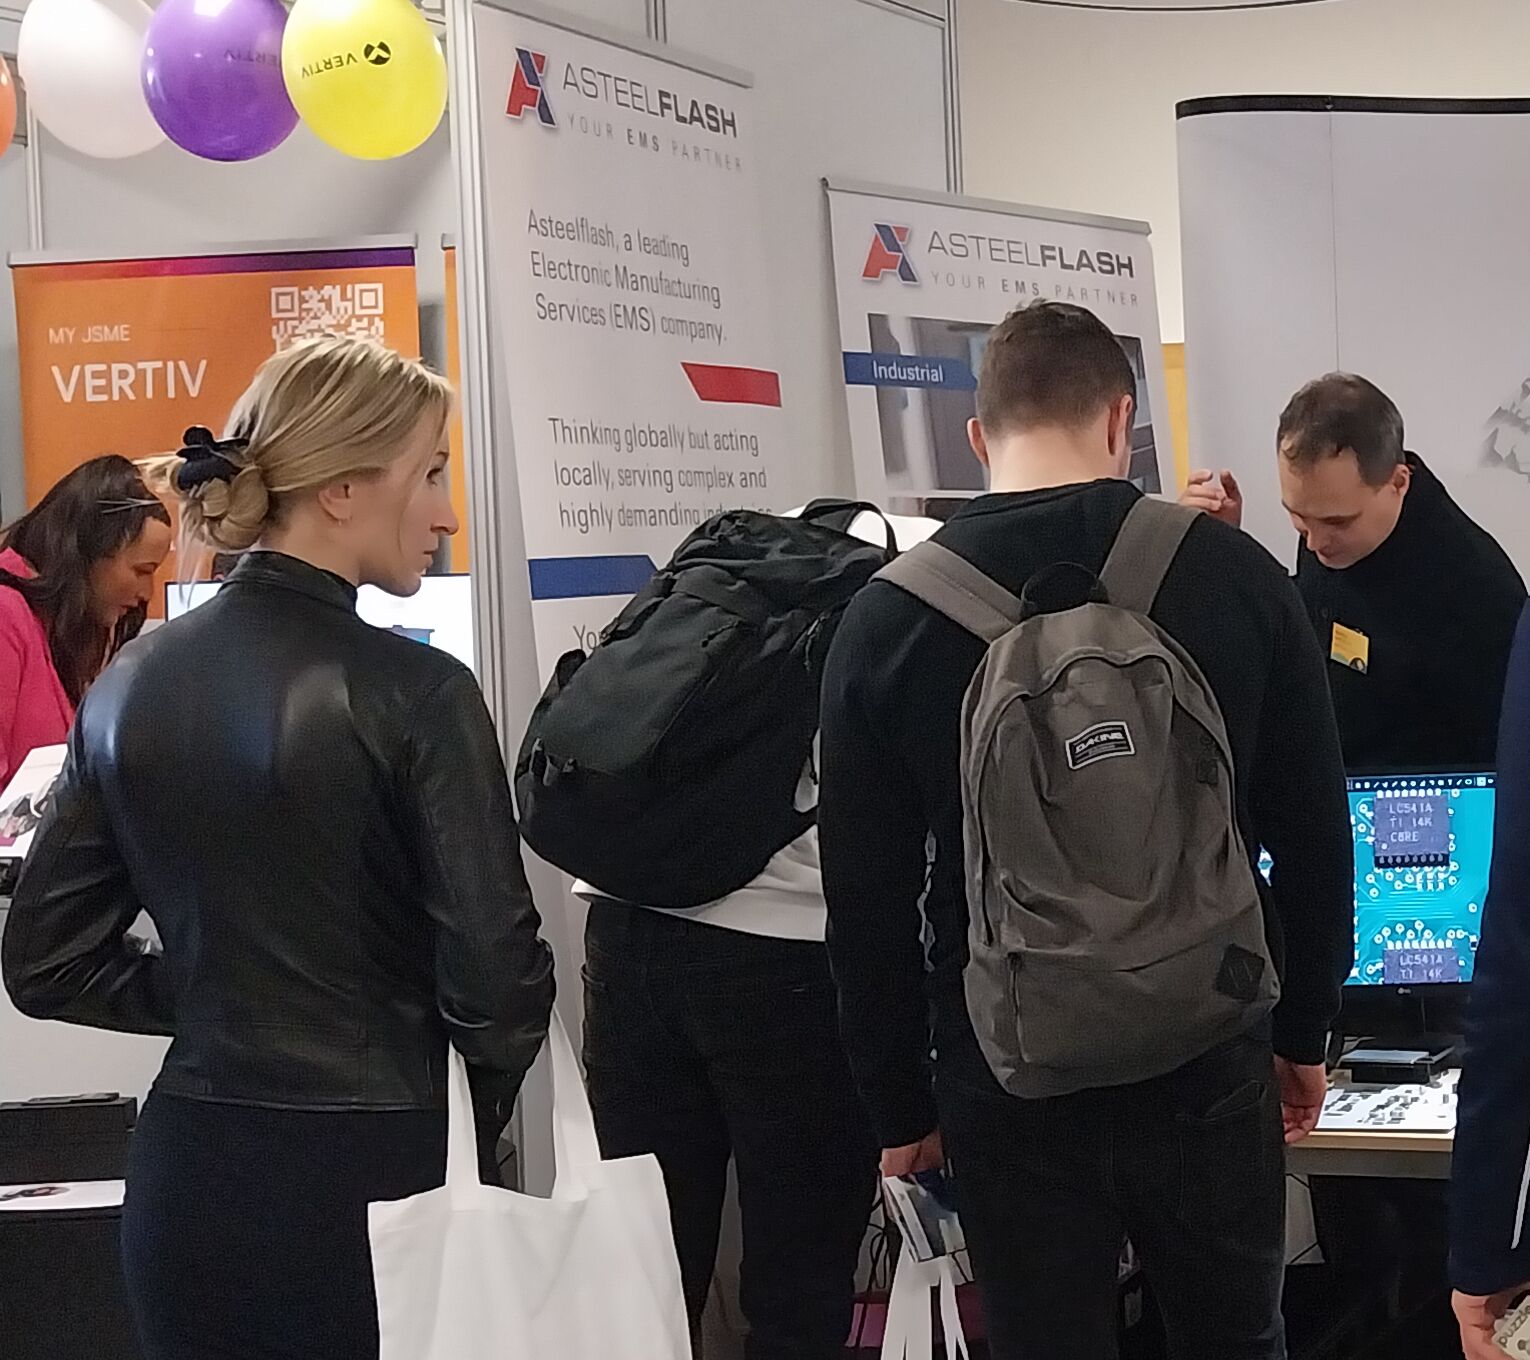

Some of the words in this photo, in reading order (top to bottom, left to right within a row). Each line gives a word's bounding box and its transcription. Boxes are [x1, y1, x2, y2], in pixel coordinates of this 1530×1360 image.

[301, 52, 359, 79] VERTIV
[563, 62, 737, 138] ASTEELFLASH
[567, 113, 613, 139] YOUR
[627, 128, 659, 152] EMS
[671, 140, 743, 172] PARTNER
[527, 208, 619, 251] Asteelflash,
[637, 227, 690, 268] leading
[927, 230, 1135, 278] ASTEELFLASH
[531, 250, 612, 287] Electronic
[615, 264, 721, 309] Manufacturing
[930, 270, 986, 289] YOUR
[1001, 279, 1040, 297] EMS
[1055, 285, 1139, 306] PARTNER
[536, 292, 606, 326] Services
[609, 304, 656, 334] (EMS)
[48, 327, 75, 344] MY
[82, 324, 131, 343] JSME
[50, 359, 208, 403] VERTIV
[872, 360, 944, 383] Industrial
[548, 416, 621, 454] Thinking
[624, 423, 685, 455] globally
[689, 427, 709, 451] but
[713, 427, 759, 457] acting
[617, 465, 674, 494] serving
[677, 466, 735, 491] complex
[739, 467, 767, 489] and
[559, 503, 613, 534] highly
